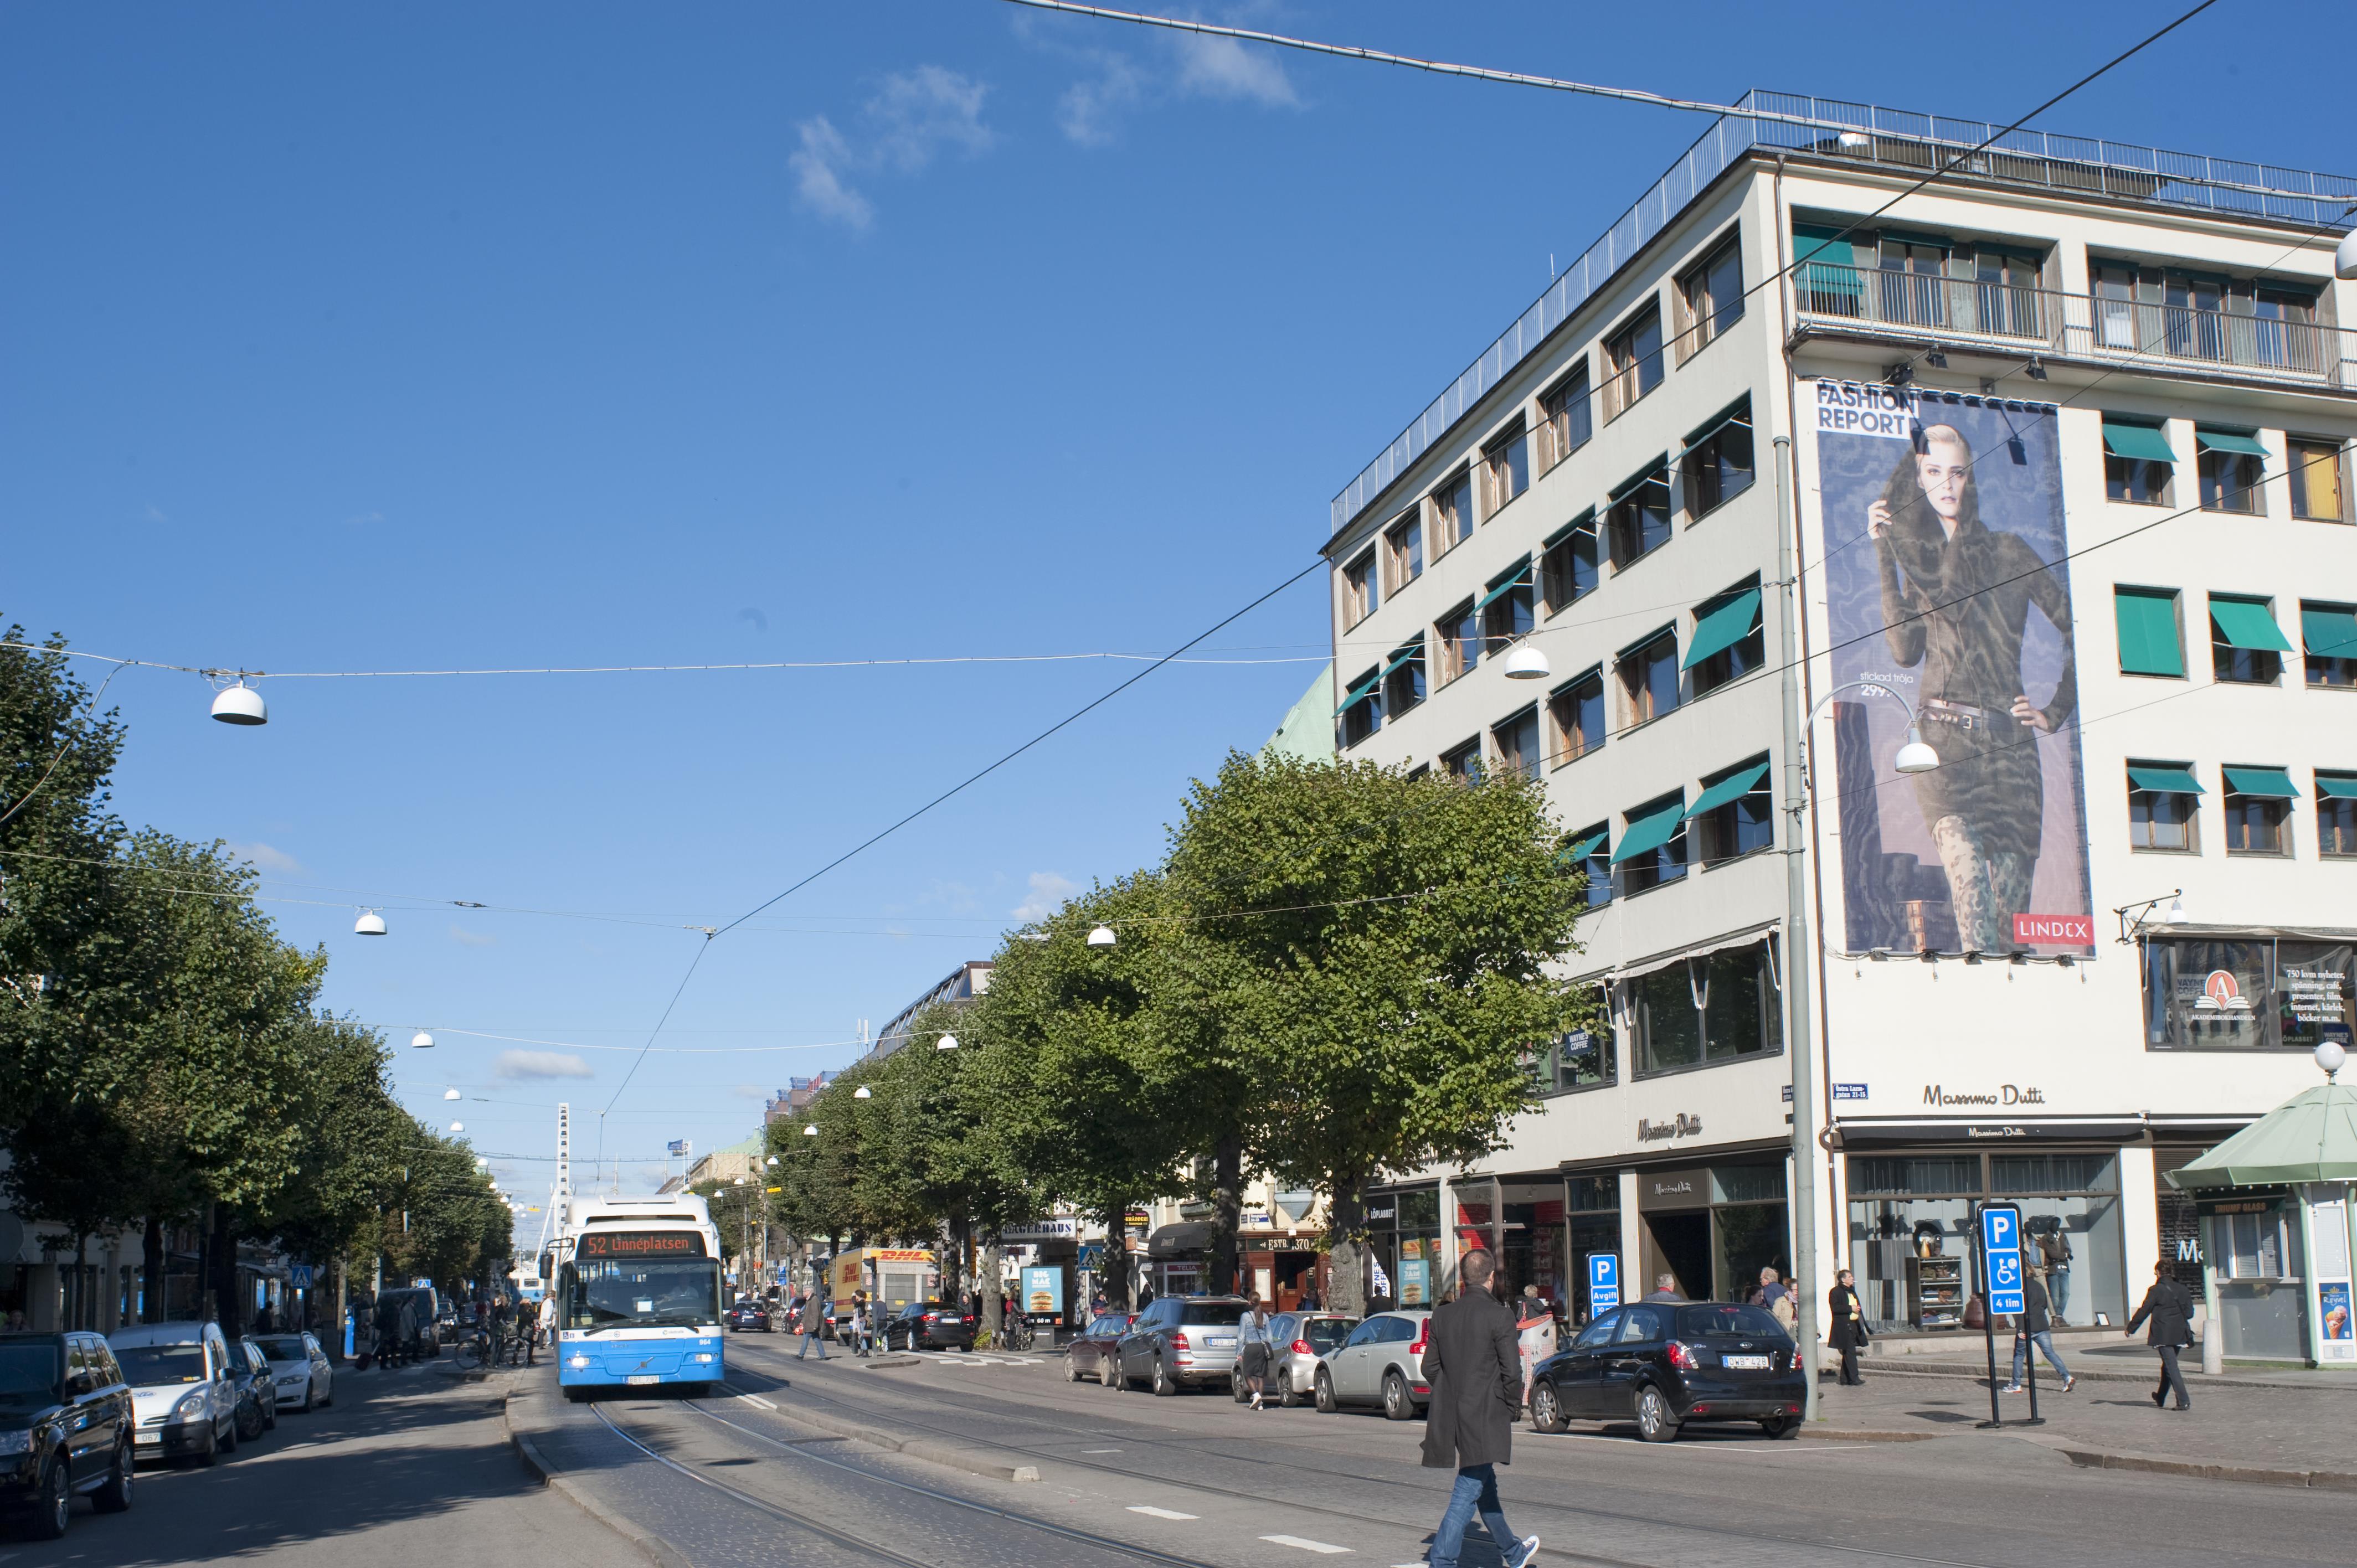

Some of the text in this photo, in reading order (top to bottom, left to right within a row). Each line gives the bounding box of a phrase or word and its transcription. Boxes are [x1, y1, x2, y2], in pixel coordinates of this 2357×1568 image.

[1817, 384, 1915, 413] FASHION
[1818, 407, 1905, 435] REPORT
[1860, 671, 1914, 684] stickad tröja
[2020, 921, 2087, 938] LINDEX
[2287, 969, 2345, 979] 750 kvm nyheter,
[2327, 992, 2343, 1001] film,
[1571, 1040, 1588, 1051] COFFEE
[1923, 1085, 2046, 1107] Massimo Dutti
[1638, 1113, 1702, 1143] Massimo Dutti
[1968, 1127, 2026, 1137] Massimo Dutti
[2215, 1203, 2266, 1213] TRIUMF GLASS
[1993, 1217, 2009, 1243] P
[588, 1236, 688, 1254] 52 Linnéplatsen
[1268, 1239, 1289, 1250] ESTB.
[880, 1251, 924, 1261] DHL
[1597, 1261, 1610, 1281] P
[1593, 1292, 1617, 1301] Avgift
[1996, 1298, 2020, 1308] 4 tim
[142, 1433, 158, 1442] 067
